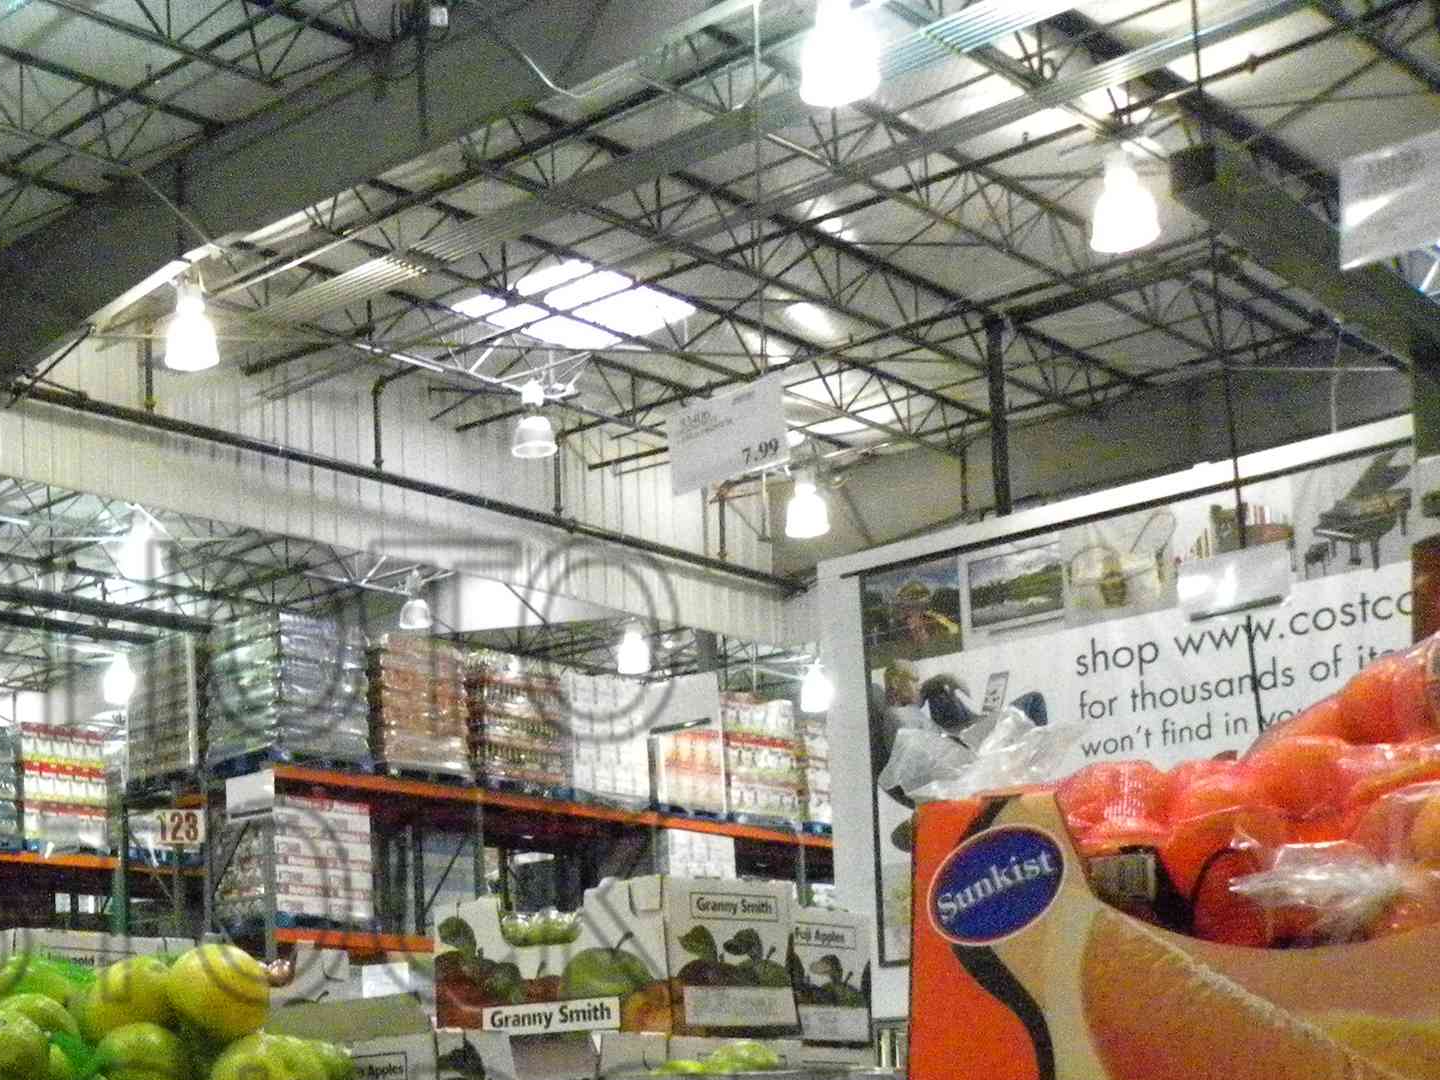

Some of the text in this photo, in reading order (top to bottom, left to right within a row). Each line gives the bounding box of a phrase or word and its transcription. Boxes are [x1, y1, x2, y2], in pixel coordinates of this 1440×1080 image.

[742, 438, 780, 465] 7.99
[1075, 638, 1159, 677] shop
[1080, 689, 1117, 719] for
[1131, 657, 1295, 712] thousands
[1310, 645, 1342, 682] of
[1081, 725, 1152, 758] won't
[1161, 712, 1211, 746] find
[1225, 713, 1248, 736] in
[159, 811, 199, 841] 123
[937, 850, 1054, 924] Sunkist
[695, 896, 773, 915] Granny Smith
[490, 1002, 612, 1031] Granny Smith
